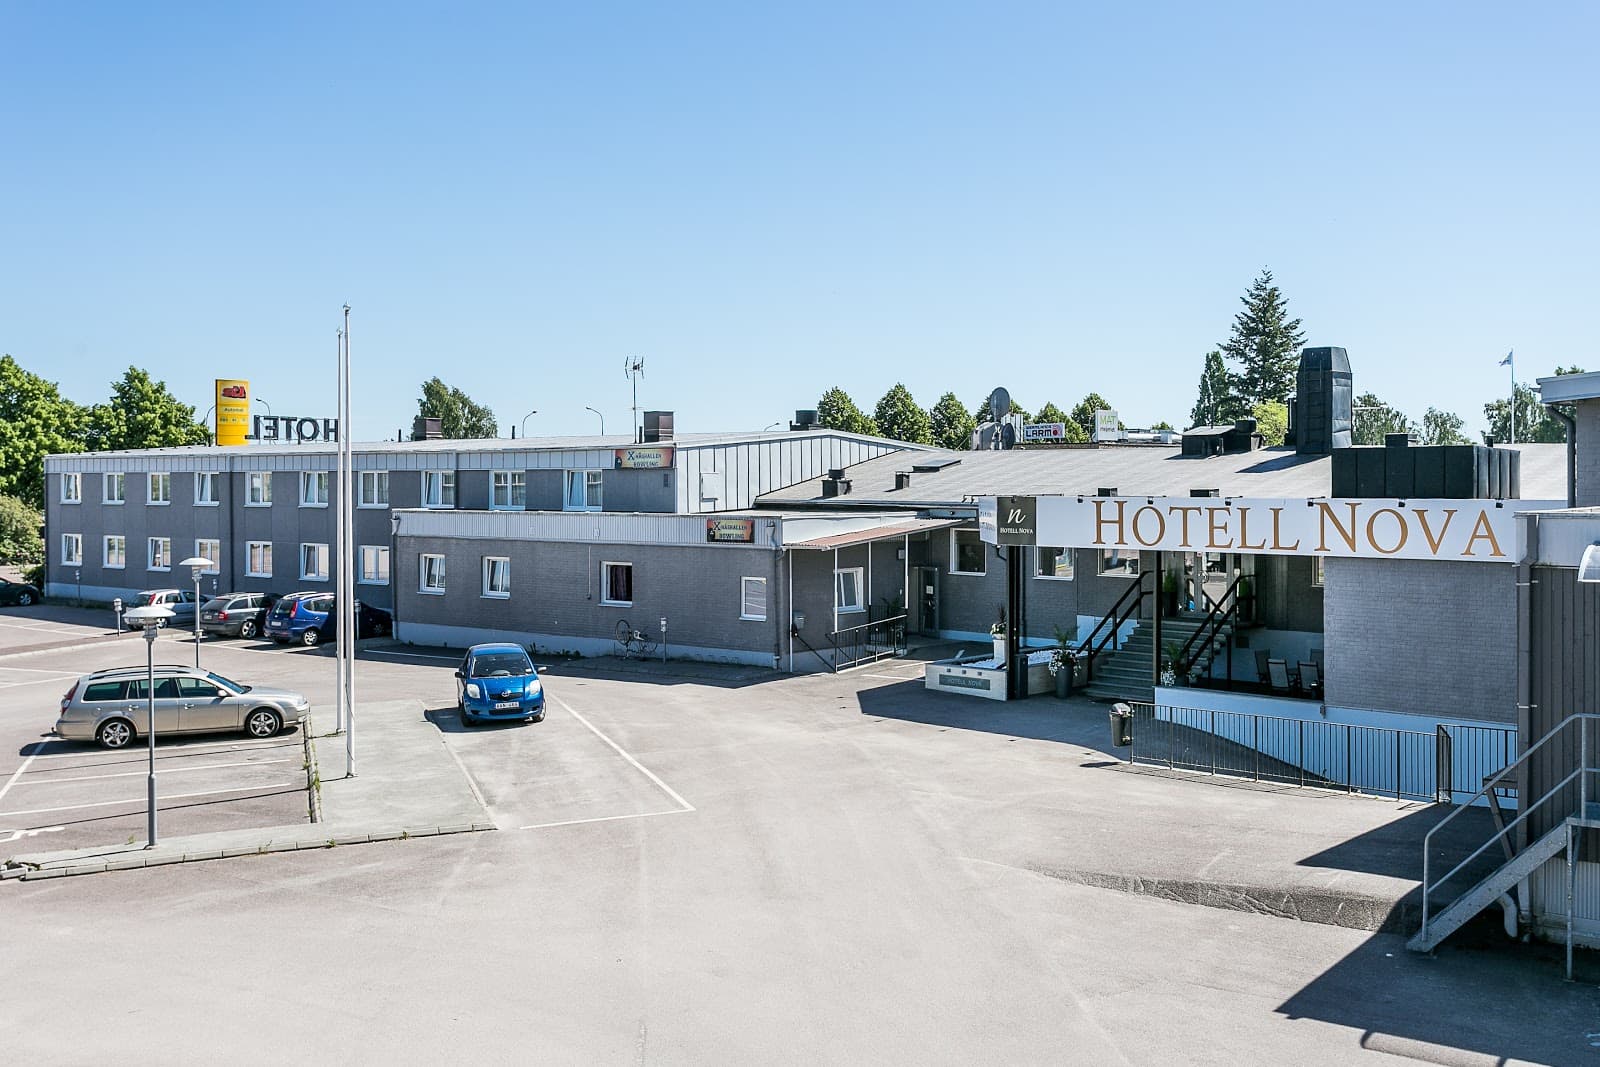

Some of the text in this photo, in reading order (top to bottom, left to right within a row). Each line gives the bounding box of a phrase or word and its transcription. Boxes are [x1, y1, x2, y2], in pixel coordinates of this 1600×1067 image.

[1026, 429, 1052, 437] LARM
[1019, 527, 1033, 535] NOVA
[1092, 500, 1506, 557] HOTELL NOVA
